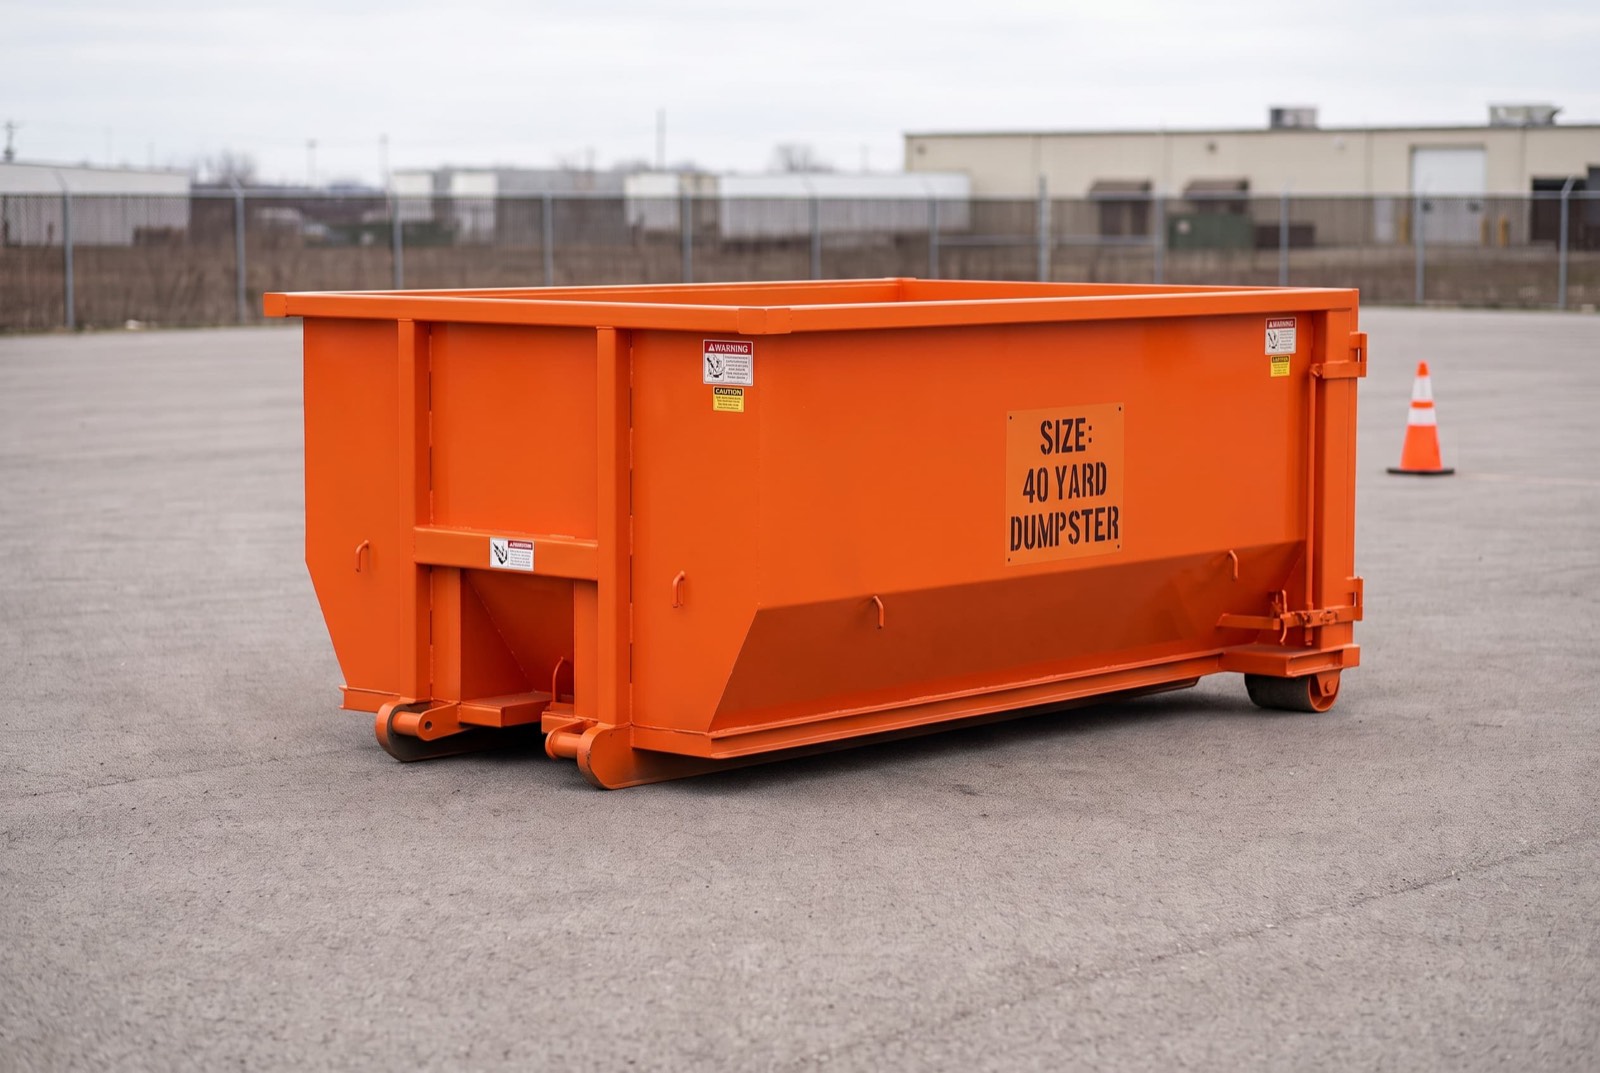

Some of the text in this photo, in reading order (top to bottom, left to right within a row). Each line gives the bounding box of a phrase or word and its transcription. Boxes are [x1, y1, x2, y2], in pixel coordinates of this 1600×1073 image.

[714, 344, 749, 353] WARNING
[1040, 417, 1092, 455] SIZE:
[1022, 461, 1107, 503] 40 YARD
[1010, 505, 1119, 551] DUMPSTER
